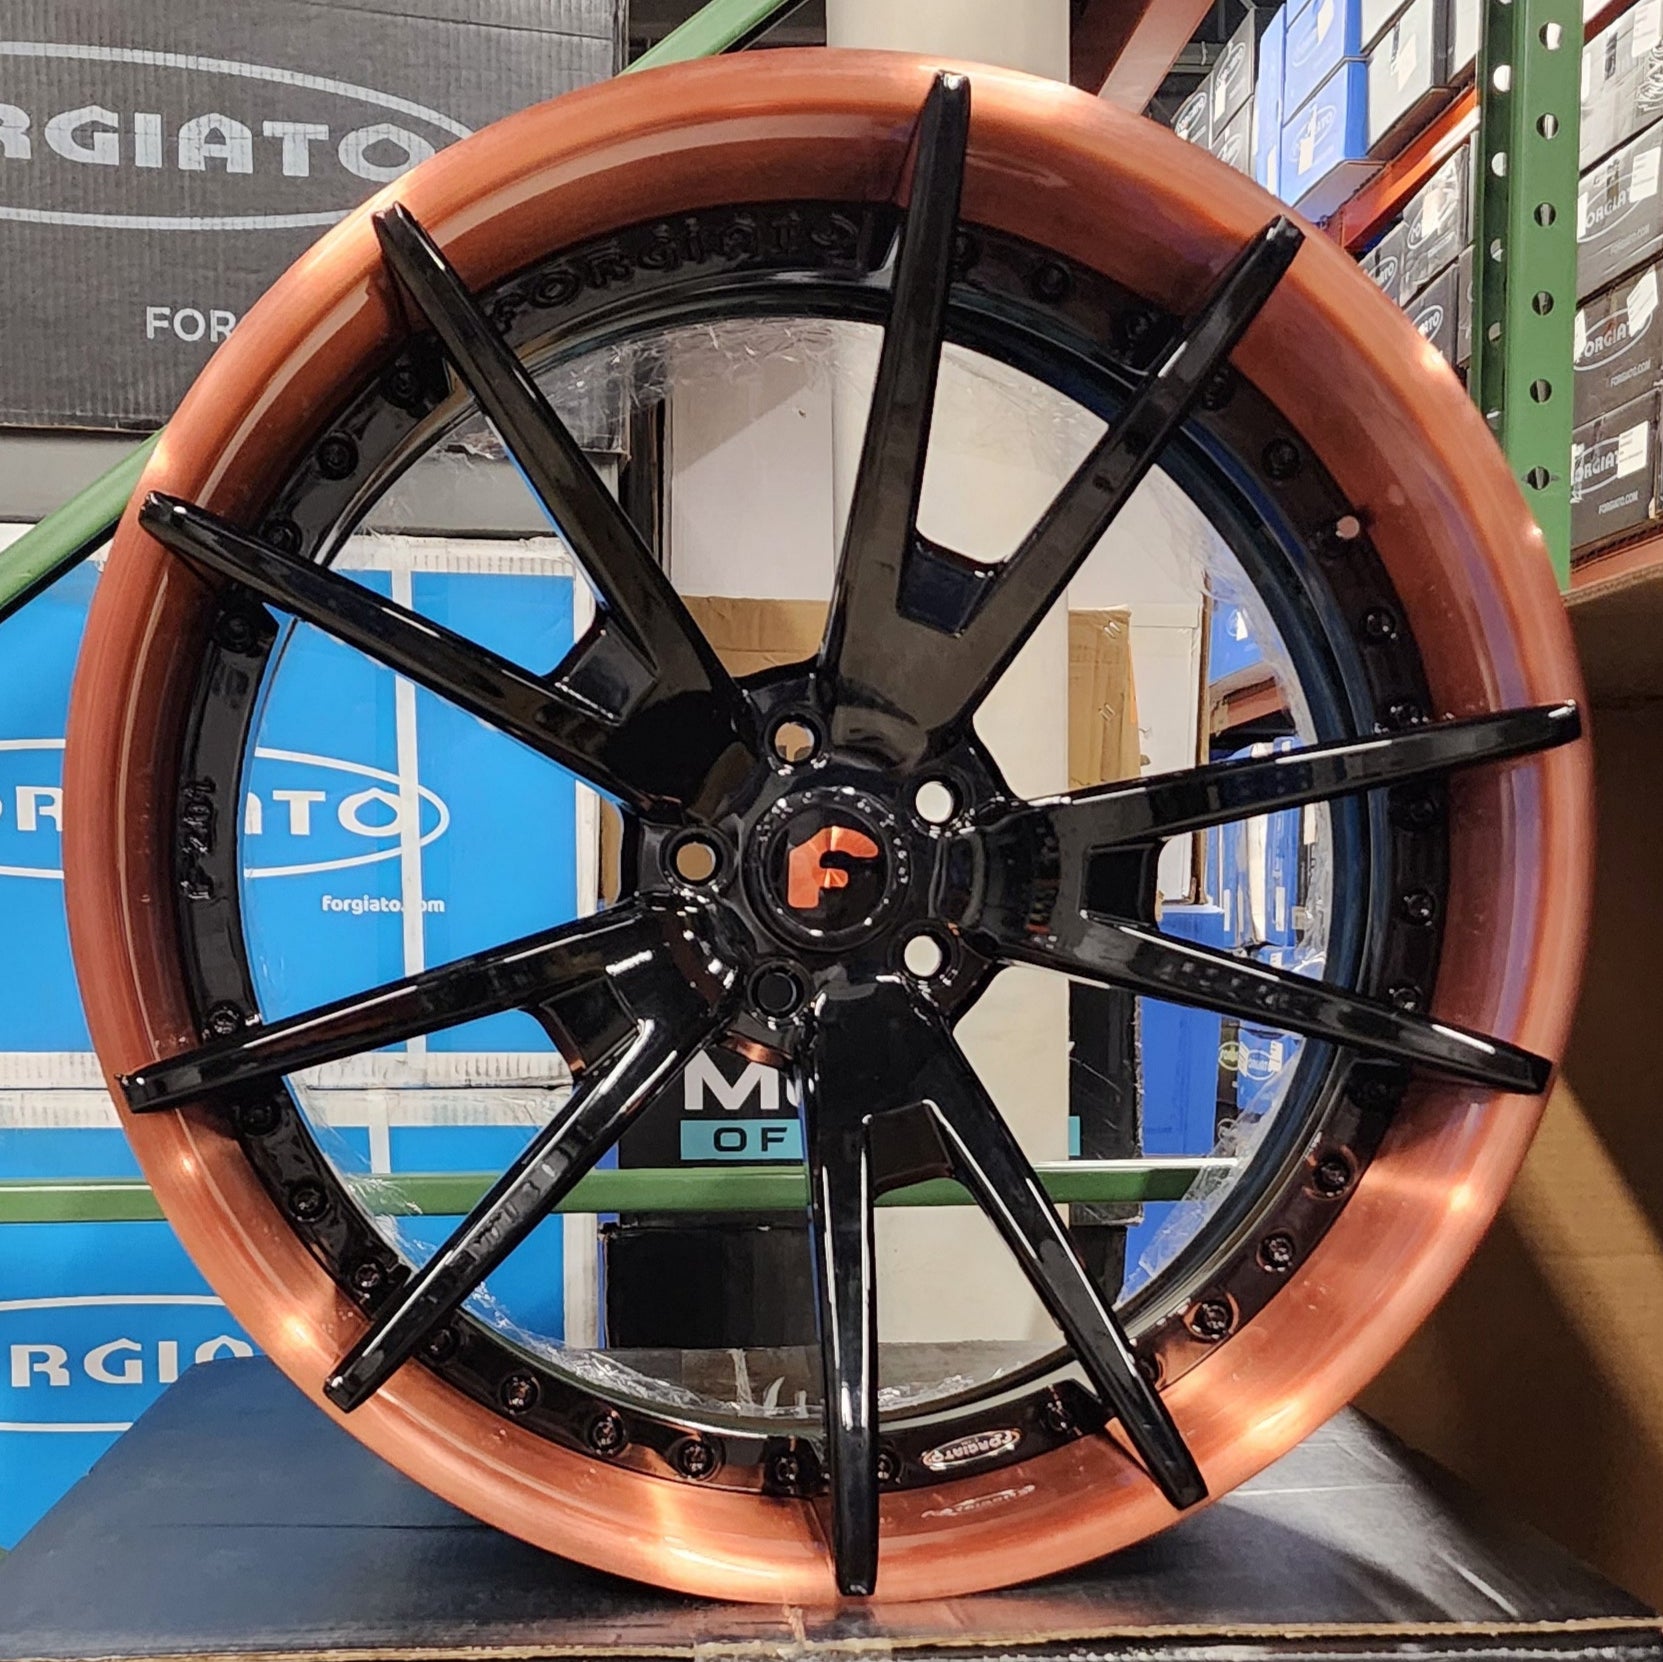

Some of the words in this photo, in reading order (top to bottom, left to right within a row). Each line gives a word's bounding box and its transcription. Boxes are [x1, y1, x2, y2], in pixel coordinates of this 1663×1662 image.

[1585, 187, 1631, 229] ORGIA
[1584, 320, 1630, 357] ORGIA
[321, 894, 445, 915] forgiato.om
[713, 1127, 788, 1152] OF
